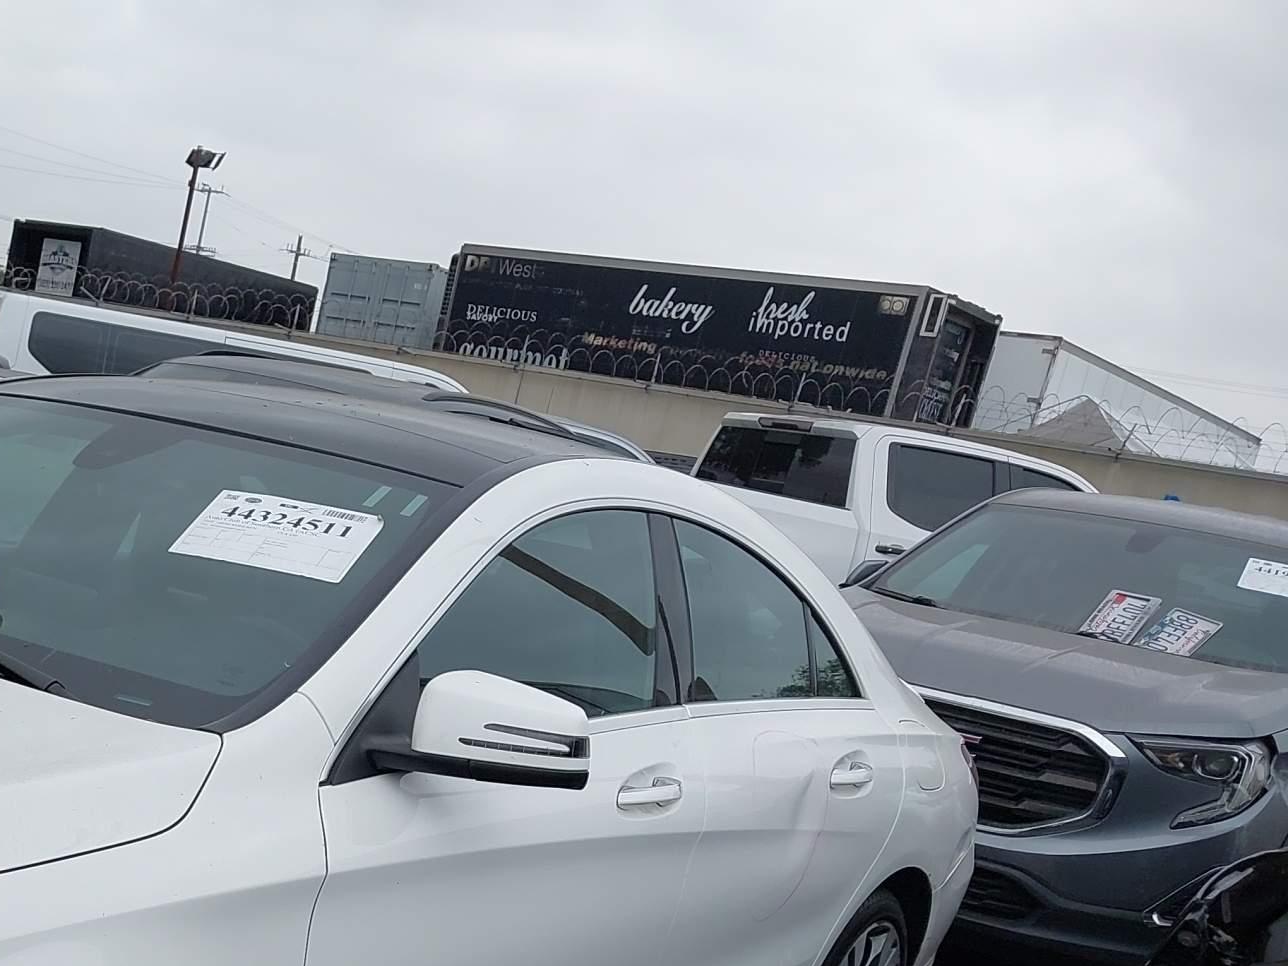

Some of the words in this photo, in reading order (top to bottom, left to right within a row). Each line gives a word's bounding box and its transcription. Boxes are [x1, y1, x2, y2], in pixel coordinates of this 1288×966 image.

[498, 257, 537, 280] West
[466, 303, 539, 323] DELICIOUS
[628, 284, 716, 334] bakery
[758, 286, 816, 328] fresh
[581, 331, 658, 355] Marketing
[748, 311, 852, 343] imported
[220, 505, 353, 538] 44324511
